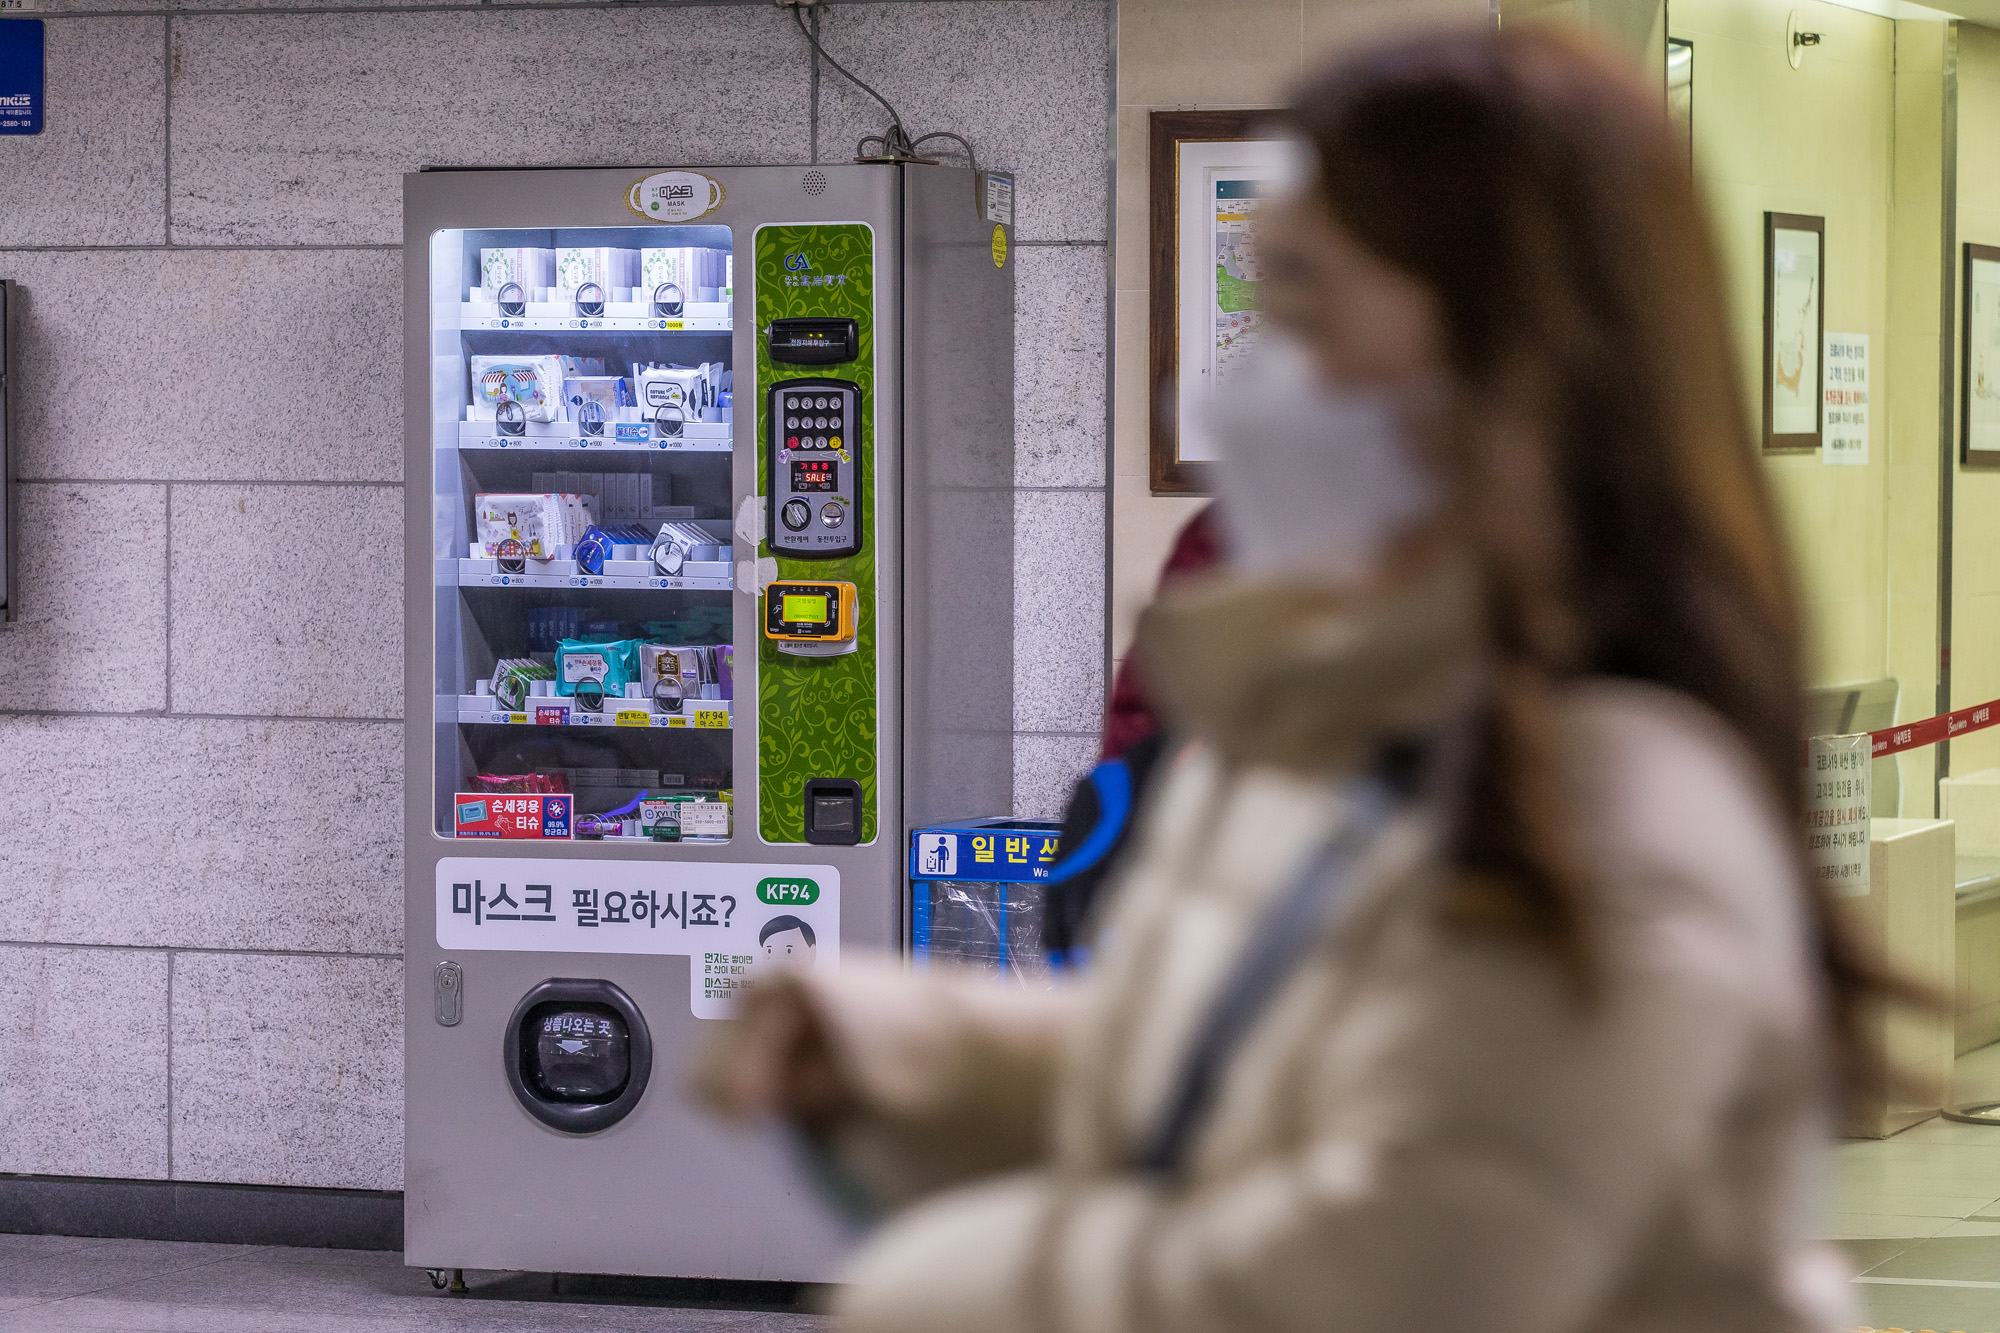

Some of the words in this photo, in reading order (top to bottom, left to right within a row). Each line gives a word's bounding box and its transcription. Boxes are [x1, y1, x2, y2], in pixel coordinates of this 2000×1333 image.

[660, 185, 694, 200] 마스크
[805, 473, 826, 482] SALE
[784, 535, 809, 543] 반환레버
[817, 535, 847, 543] 동전투입구
[699, 711, 710, 720] KF
[712, 711, 724, 720] 94
[1972, 707, 1989, 725] 서울메트로
[1893, 729, 1912, 746] 서울메트로
[491, 799, 540, 814] 손세정용
[516, 816, 540, 830] 티슈
[544, 828, 568, 836] 항균효과
[765, 883, 811, 901] KF94
[452, 879, 557, 926] 마스크
[571, 888, 738, 930] 필요하시죠?
[704, 952, 730, 964] 먼지도
[704, 964, 712, 974] 큰
[713, 965, 728, 974] 산이
[730, 965, 747, 975] 된다.
[704, 977, 739, 989] 마스크는
[543, 1017, 595, 1034] 상품나오는
[598, 1020, 611, 1035] 곳
